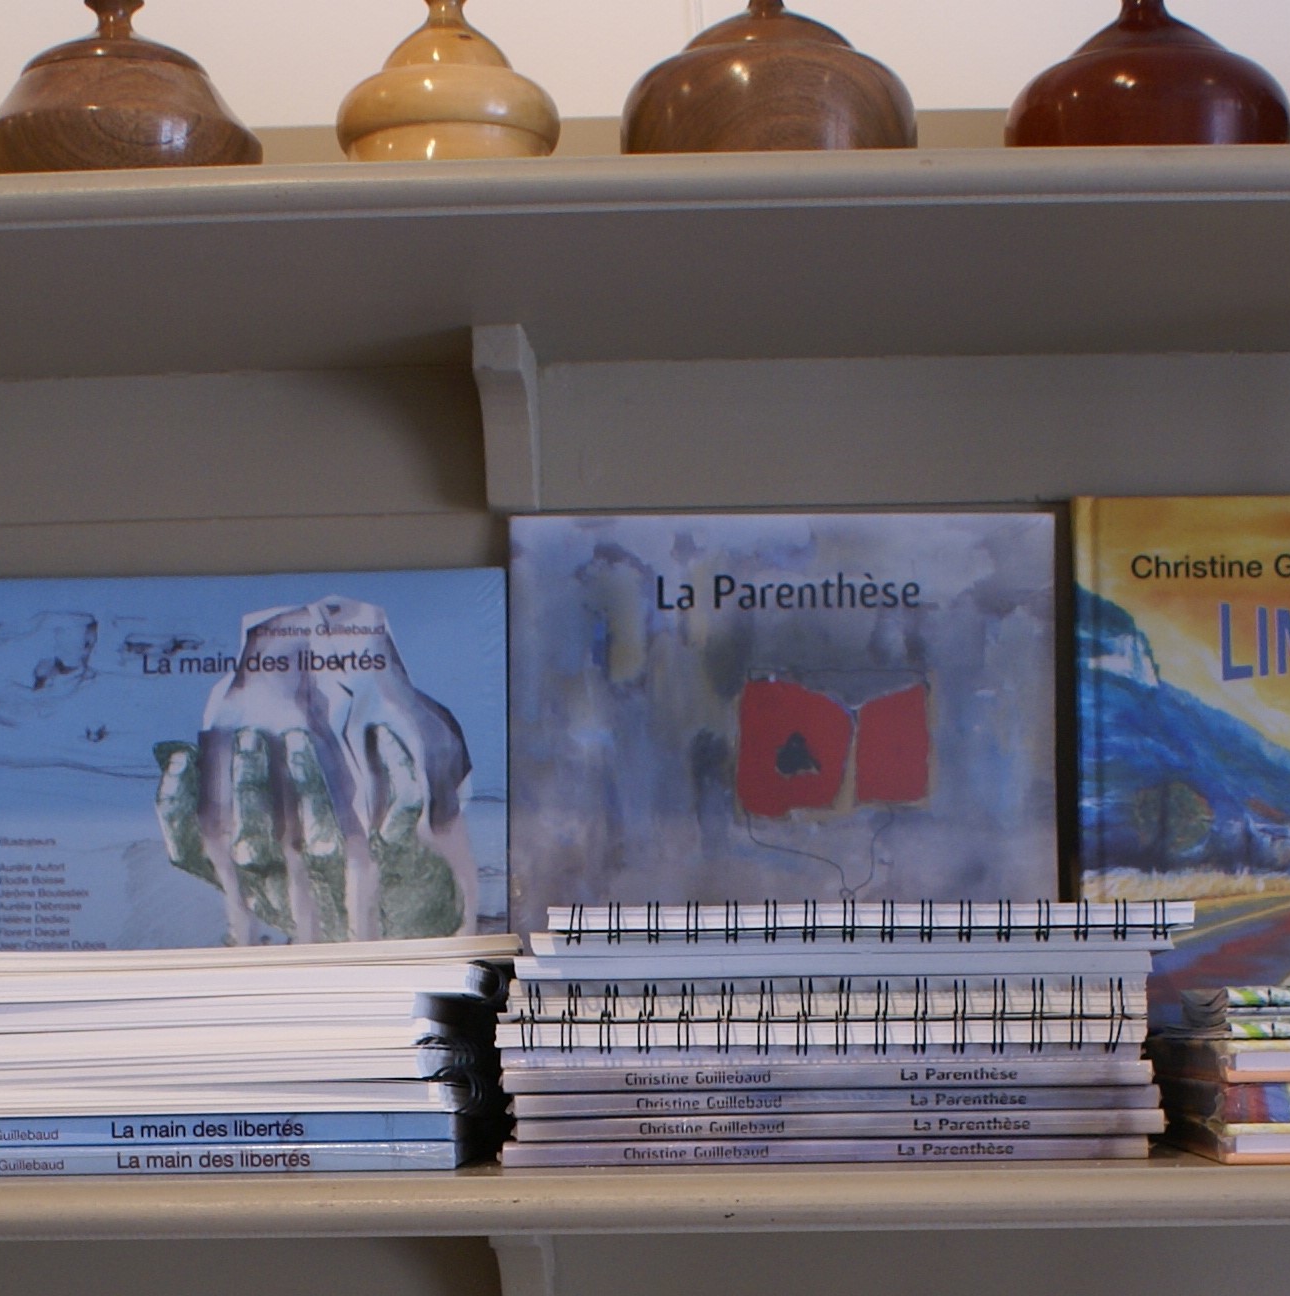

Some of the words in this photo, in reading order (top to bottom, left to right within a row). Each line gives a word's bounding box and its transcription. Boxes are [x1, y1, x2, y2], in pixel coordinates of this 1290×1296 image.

[1131, 556, 1263, 580] Christine
[656, 576, 694, 610] La
[714, 572, 920, 609] Parenthèse
[142, 654, 171, 674] La
[180, 652, 238, 672] main
[247, 651, 289, 672] des
[298, 648, 386, 670] libertés
[625, 1072, 689, 1086] Christine
[900, 1068, 918, 1081] La
[925, 1067, 1018, 1081] Parenthèse
[636, 1097, 700, 1110] Christine
[707, 1096, 782, 1109] Guillebaud
[910, 1094, 928, 1107] La
[935, 1092, 1027, 1106] Parenthèse
[111, 1121, 135, 1138] La
[141, 1120, 186, 1138] main
[193, 1119, 228, 1138] des
[234, 1117, 303, 1137] libertés
[639, 1122, 703, 1135] Christine
[709, 1121, 784, 1134] Guillebaud
[913, 1118, 931, 1131] La
[938, 1117, 1031, 1131] Parenthèse
[117, 1152, 140, 1169] La
[146, 1150, 192, 1169] main
[199, 1149, 234, 1168] des
[240, 1147, 311, 1168] libertés
[623, 1147, 687, 1160] Christine
[693, 1146, 769, 1159] Guillebaud
[897, 1143, 915, 1156] La
[922, 1142, 1014, 1156] Parenthèse
